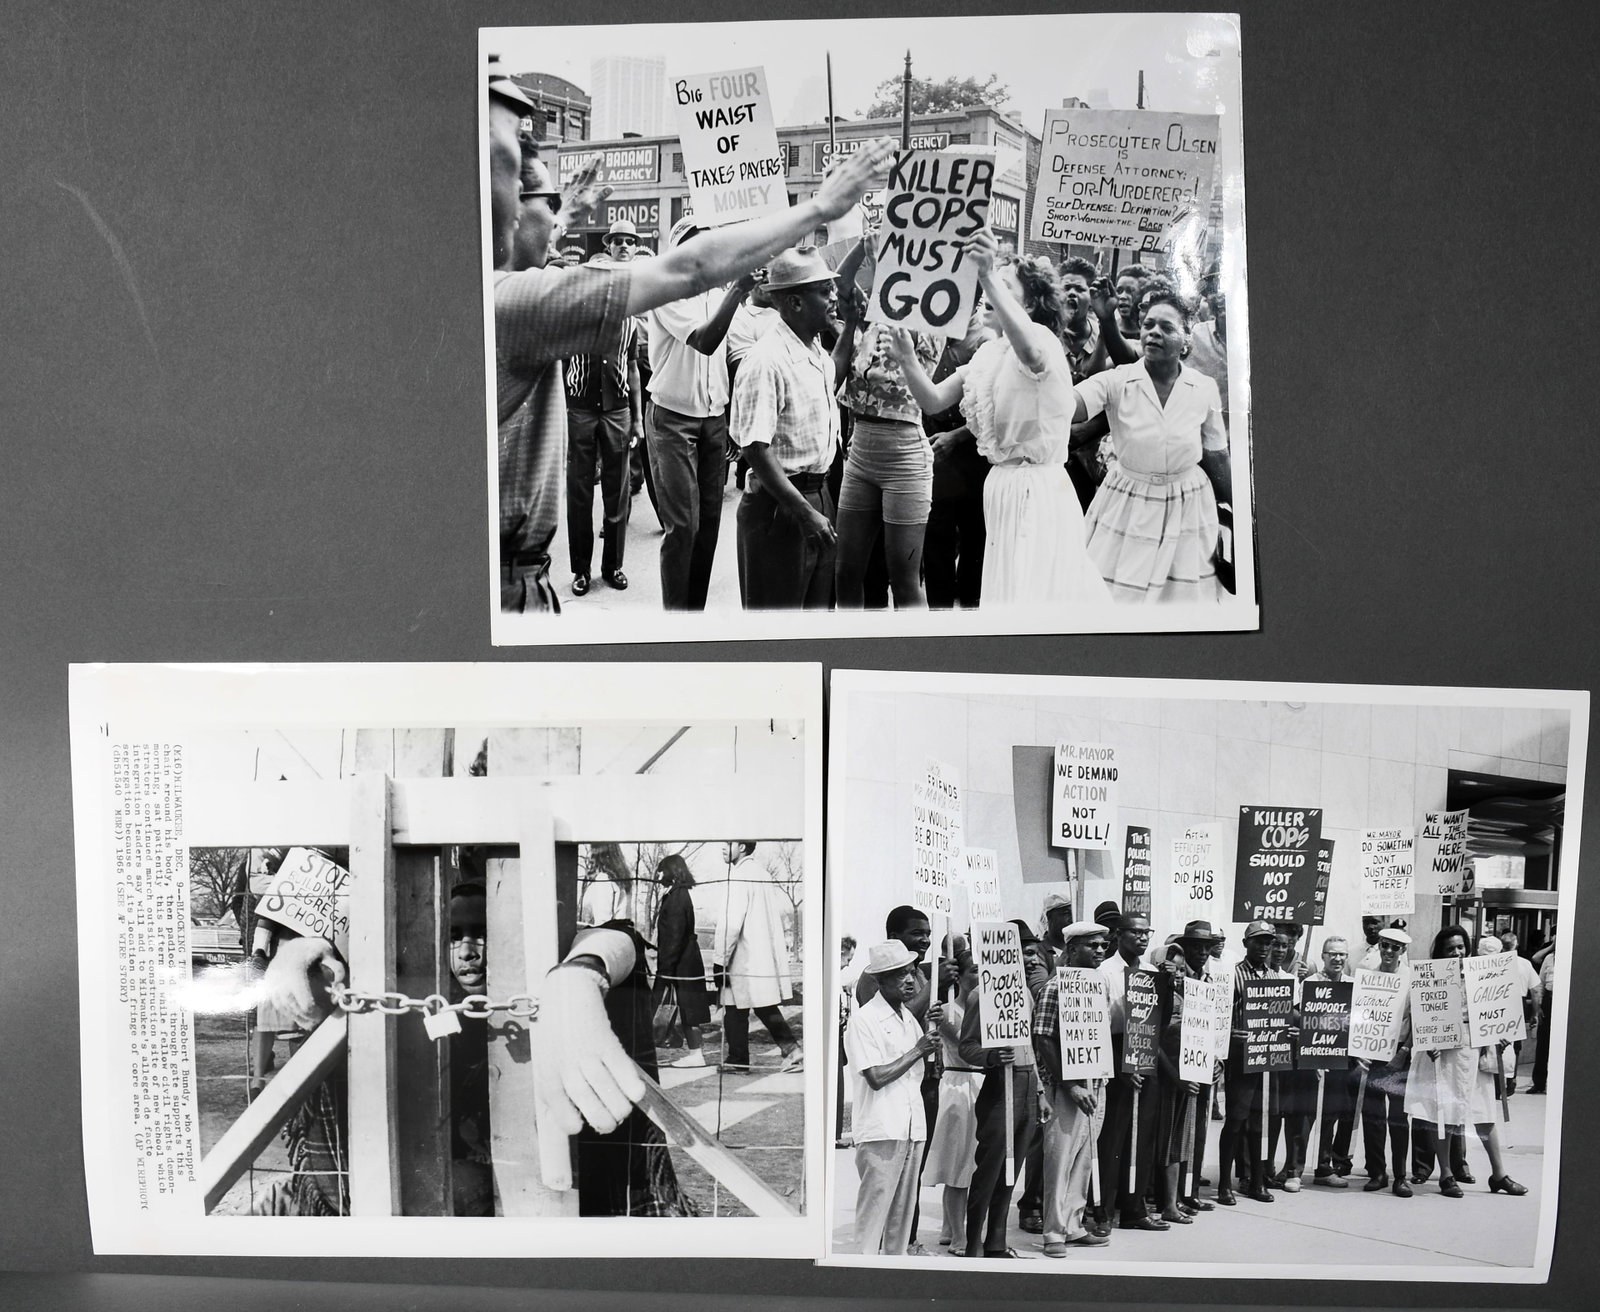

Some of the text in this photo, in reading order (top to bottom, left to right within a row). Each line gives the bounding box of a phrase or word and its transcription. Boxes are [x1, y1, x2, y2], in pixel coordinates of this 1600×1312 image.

[709, 72, 761, 101] FOUR
[695, 102, 757, 130] WAIST
[716, 134, 740, 154] OF
[1050, 119, 1217, 154] PROSECUTER OLSEN
[606, 149, 653, 167] BADAMO
[1052, 155, 1106, 174] DEFENSE
[1117, 150, 1128, 160] IS
[608, 167, 653, 181] AGENCY
[690, 157, 781, 188] TAXES PAYERS
[888, 150, 994, 198] KILLER
[713, 184, 771, 213] MONEY
[607, 205, 659, 224] BONDS
[887, 192, 989, 237] COPS
[1138, 216, 1163, 231] BACK
[878, 231, 965, 273] MUST
[880, 271, 960, 327] GO
[164, 744, 172, 776] chain
[1079, 747, 1115, 761] MAYOR
[143, 743, 152, 796] strators
[1057, 763, 1119, 782] WE DEMAND
[122, 743, 132, 816] segregation
[164, 783, 173, 822] around
[1063, 784, 1107, 802] ACTION
[154, 803, 162, 822] sat
[1072, 806, 1097, 820] NOT
[1425, 812, 1466, 825] WE WANT
[145, 803, 153, 861] continued
[926, 829, 949, 851] BITTER
[1061, 822, 1110, 846] BULL!
[1261, 826, 1309, 848] COPS
[1422, 825, 1442, 837] ALL
[1443, 830, 1466, 841] FACTS
[125, 823, 133, 868] because
[1362, 842, 1372, 852] DO
[1437, 842, 1462, 856] HERE
[154, 829, 164, 887] patiently
[917, 848, 934, 867] TOO
[1249, 853, 1305, 867] SHOULD
[1431, 854, 1465, 873] NOW!
[164, 855, 173, 886] body,
[915, 866, 948, 888] HAD BEEN
[1174, 870, 1213, 884] DID HIS
[1263, 871, 1293, 886] NOT
[1364, 863, 1413, 878] JUST STAND
[126, 874, 134, 887] of
[146, 868, 154, 900] march
[1189, 884, 1214, 901] JOB
[1265, 889, 1288, 904] GO
[127, 895, 135, 913] its
[157, 895, 165, 920] this
[266, 880, 349, 934] SEGREGA
[116, 848, 129, 1003] 1965 WIRE STORY)
[147, 907, 155, 952] outside
[128, 920, 136, 972] location
[132, 744, 154, 1157] integration leaders say will add to Milwaukee's alleged de facto
[1414, 963, 1433, 972] WHITE
[1420, 971, 1435, 979] MEN
[129, 978, 136, 991] on
[1059, 981, 1102, 995] AMERICANS
[1361, 974, 1401, 990] KILLING
[1411, 978, 1447, 989] SPEAK WITH
[149, 959, 158, 1037] construction
[994, 991, 1025, 1009] COPS
[1247, 986, 1291, 998] DILLINGER
[1315, 987, 1332, 999] WE
[1420, 991, 1447, 1001] FORKED
[1473, 982, 1514, 1004] CAUSE
[160, 992, 168, 1024] while
[1063, 996, 1093, 1008] JOIN IN
[1268, 1000, 1291, 1014] GOOD
[1420, 1002, 1449, 1012] TONGUE
[129, 998, 138, 1036] fringe
[175, 848, 195, 1183] DEC. Bundy, who wrapped
[998, 1008, 1019, 1022] ARE
[1061, 1011, 1103, 1023] YOUR CHILD
[1247, 1018, 1269, 1028] WHITE
[1362, 1009, 1393, 1023] CAUSE
[1479, 1008, 1506, 1020] MUST
[170, 1012, 179, 1056] through
[986, 1020, 1029, 1040] KILLERS
[1066, 1028, 1098, 1041] MAY BE
[1353, 1023, 1390, 1037] MUST
[1479, 1015, 1523, 1037] STOP!
[1312, 1032, 1338, 1045] LAW
[1352, 1036, 1396, 1055] STOP!
[131, 1043, 140, 1056] of
[151, 1043, 159, 1069] site
[161, 1031, 169, 1070] fellow
[1067, 1046, 1101, 1065] NEXT
[1184, 1047, 1208, 1069] BACK
[1300, 1045, 1347, 1057] ENFORCEMENT
[152, 1075, 160, 1088] of
[170, 1063, 180, 1088] gate
[162, 1076, 171, 1107] civil
[172, 1095, 183, 1145] supports
[154, 1120, 164, 1157] school
[163, 1114, 173, 1151] rights
[177, 1152, 185, 1176] this
[158, 1163, 167, 1194] which
[167, 1157, 175, 1194] demon-
